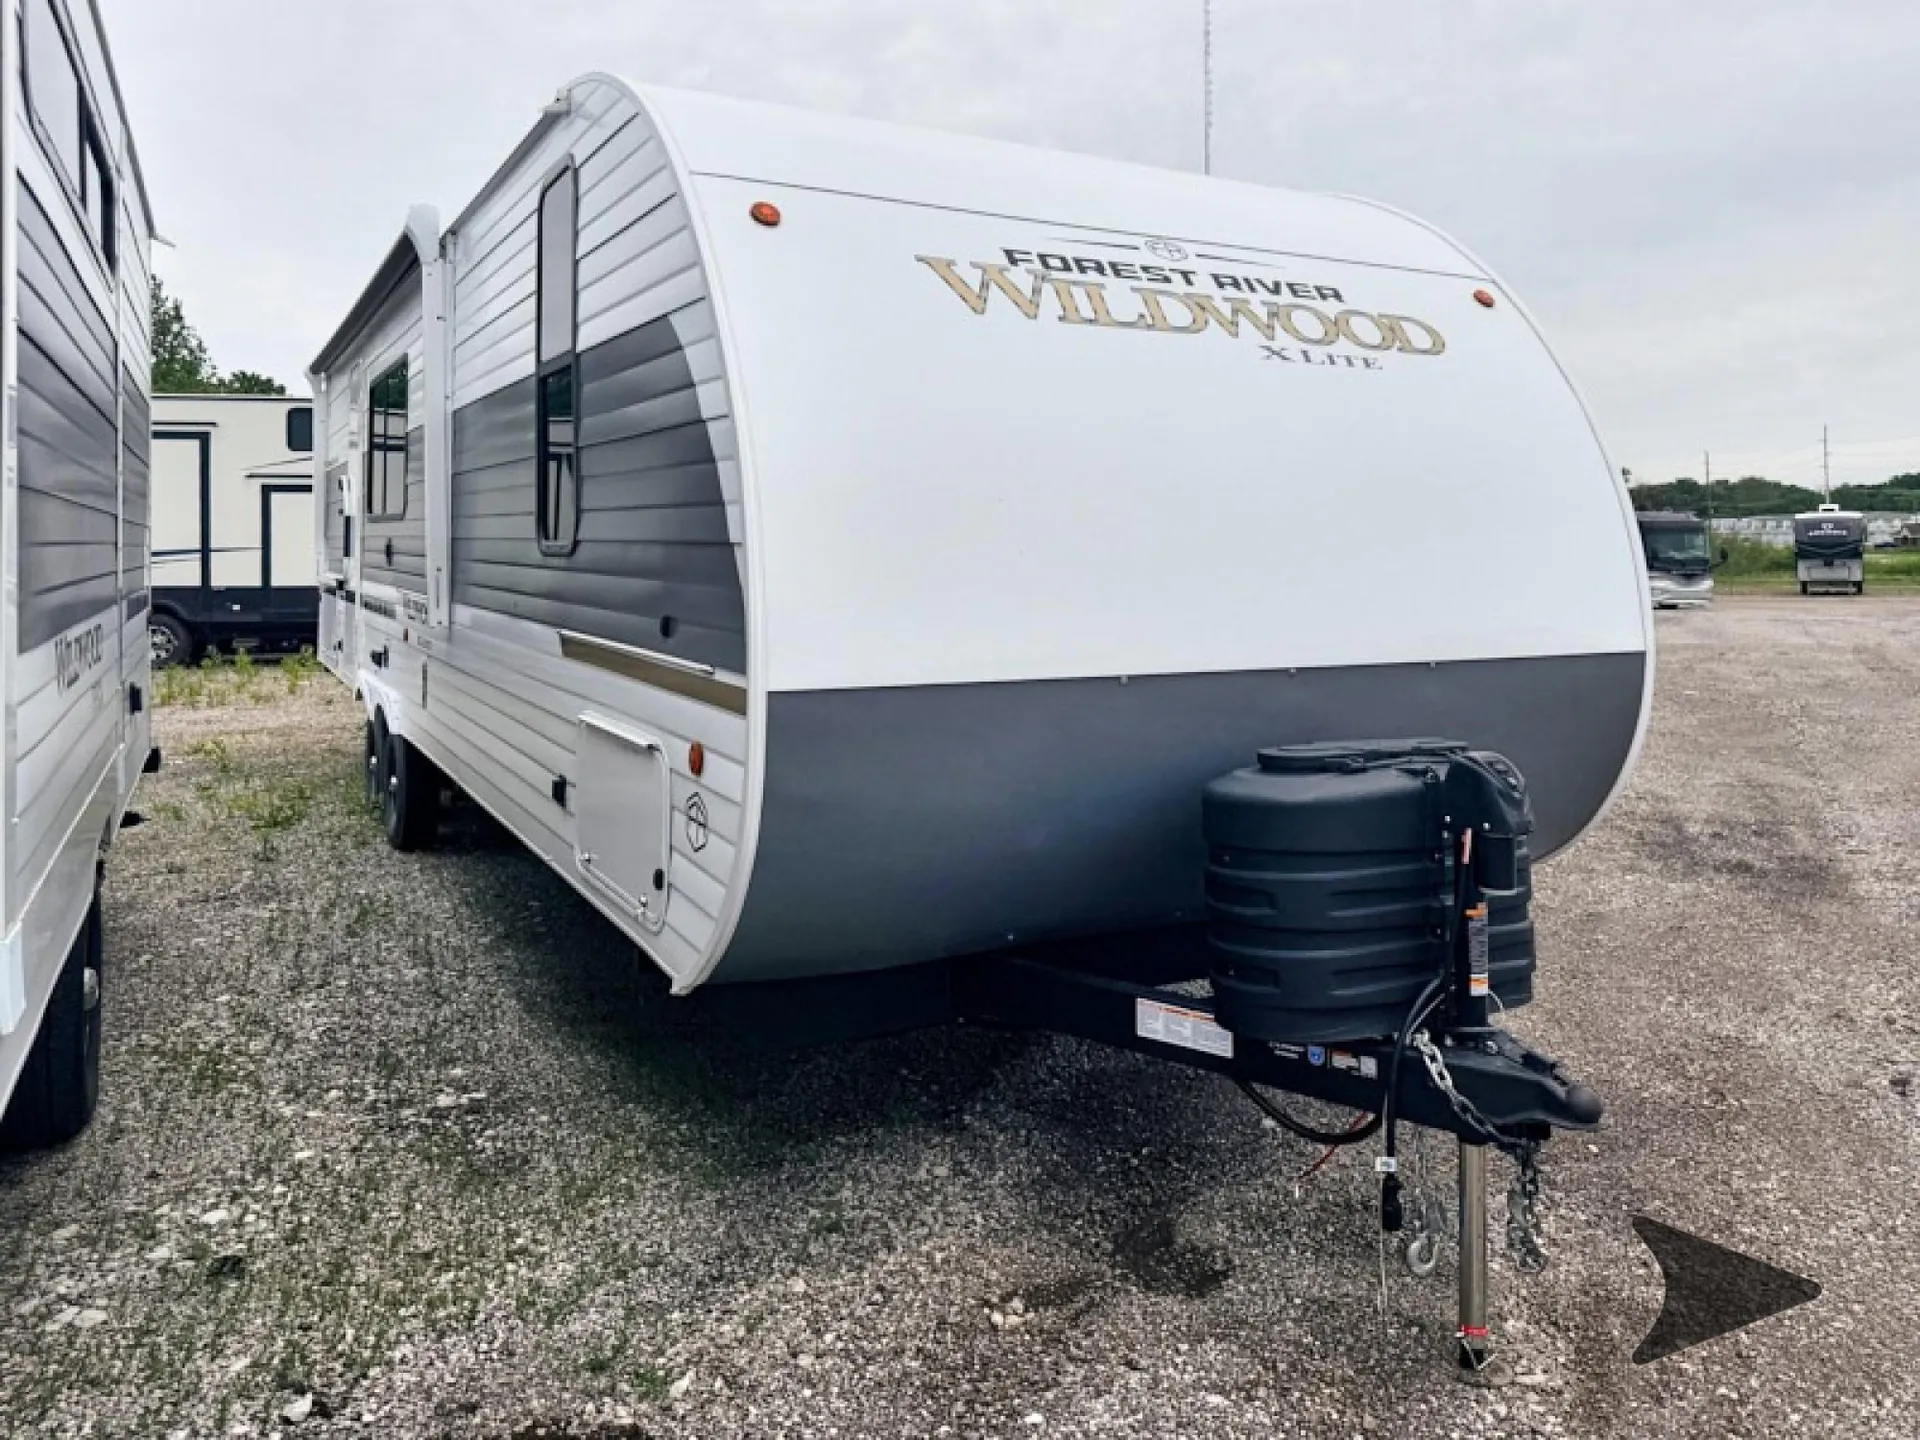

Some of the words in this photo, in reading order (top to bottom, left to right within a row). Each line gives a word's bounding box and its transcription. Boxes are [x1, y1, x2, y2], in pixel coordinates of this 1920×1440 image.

[1000, 246, 1197, 287] FOREST
[1209, 273, 1345, 303] RIVER
[914, 253, 1446, 356] WILDWOOD
[1258, 344, 1296, 363] X
[1300, 348, 1384, 371] LITE
